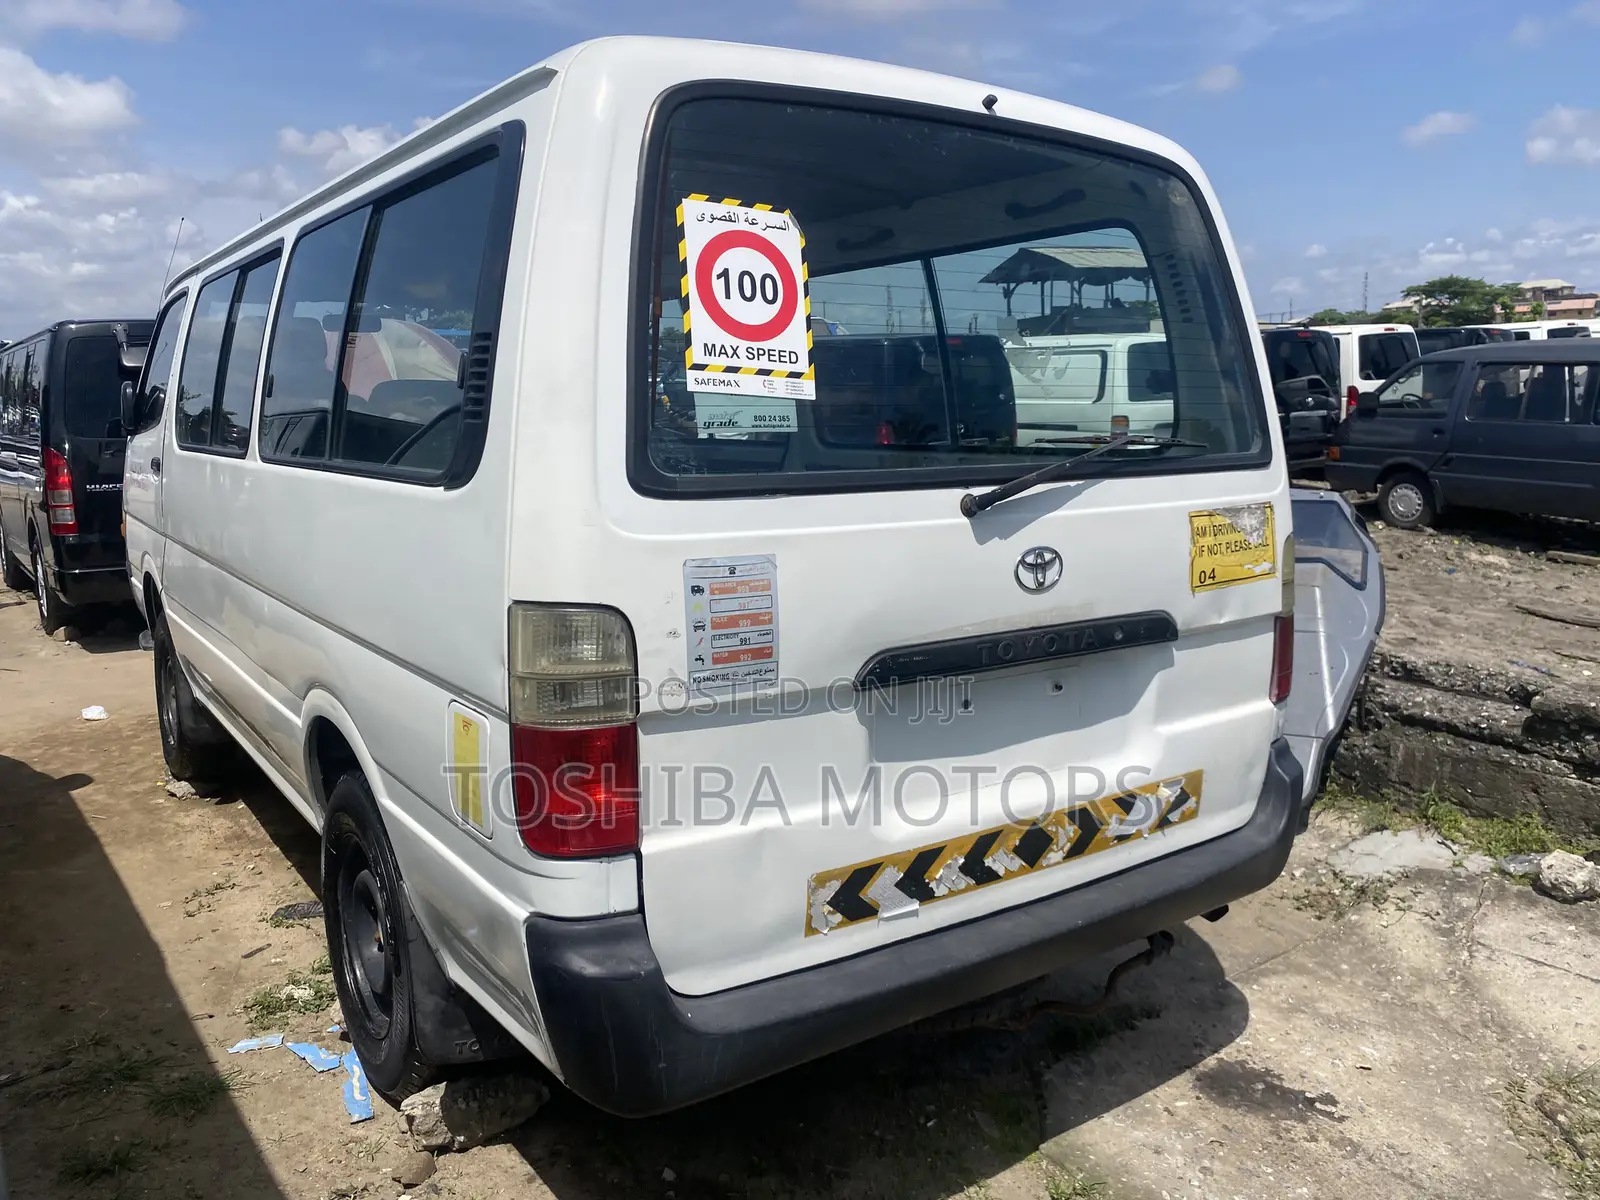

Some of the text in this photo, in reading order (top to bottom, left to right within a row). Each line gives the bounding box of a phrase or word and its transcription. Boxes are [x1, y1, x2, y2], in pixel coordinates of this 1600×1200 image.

[696, 210, 740, 224] القصوى
[716, 267, 778, 305] 100
[703, 343, 799, 365] MAX SPEED
[694, 377, 741, 388] SAFEMAX
[703, 419, 738, 429] grade
[1195, 526, 1207, 538] AM
[1198, 545, 1205, 558] IF
[1198, 568, 1216, 584] 04
[713, 633, 739, 641] ELECTRICITY
[740, 637, 751, 645] 991
[976, 628, 1100, 665] TOYOTA
[692, 673, 730, 684] NO SMOKING
